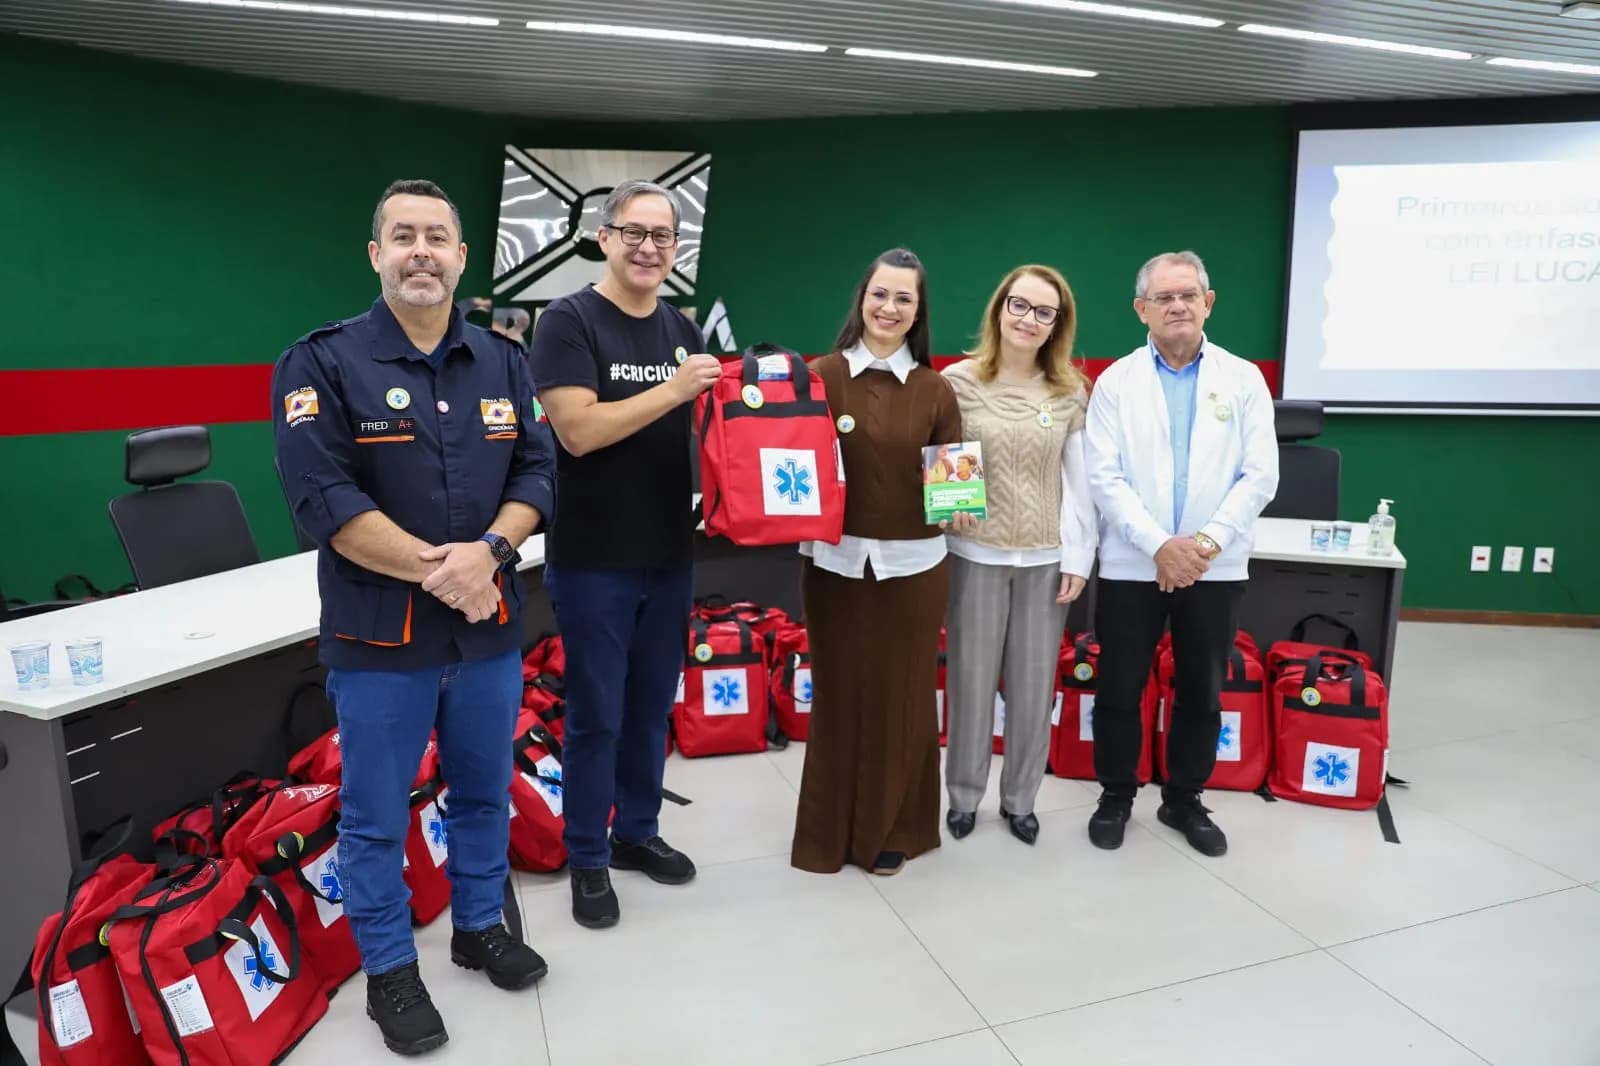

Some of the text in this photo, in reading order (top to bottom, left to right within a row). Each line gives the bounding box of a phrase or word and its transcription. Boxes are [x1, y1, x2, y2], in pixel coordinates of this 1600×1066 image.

[1449, 261, 1501, 285] LEI
[360, 419, 413, 432] FRED A+
